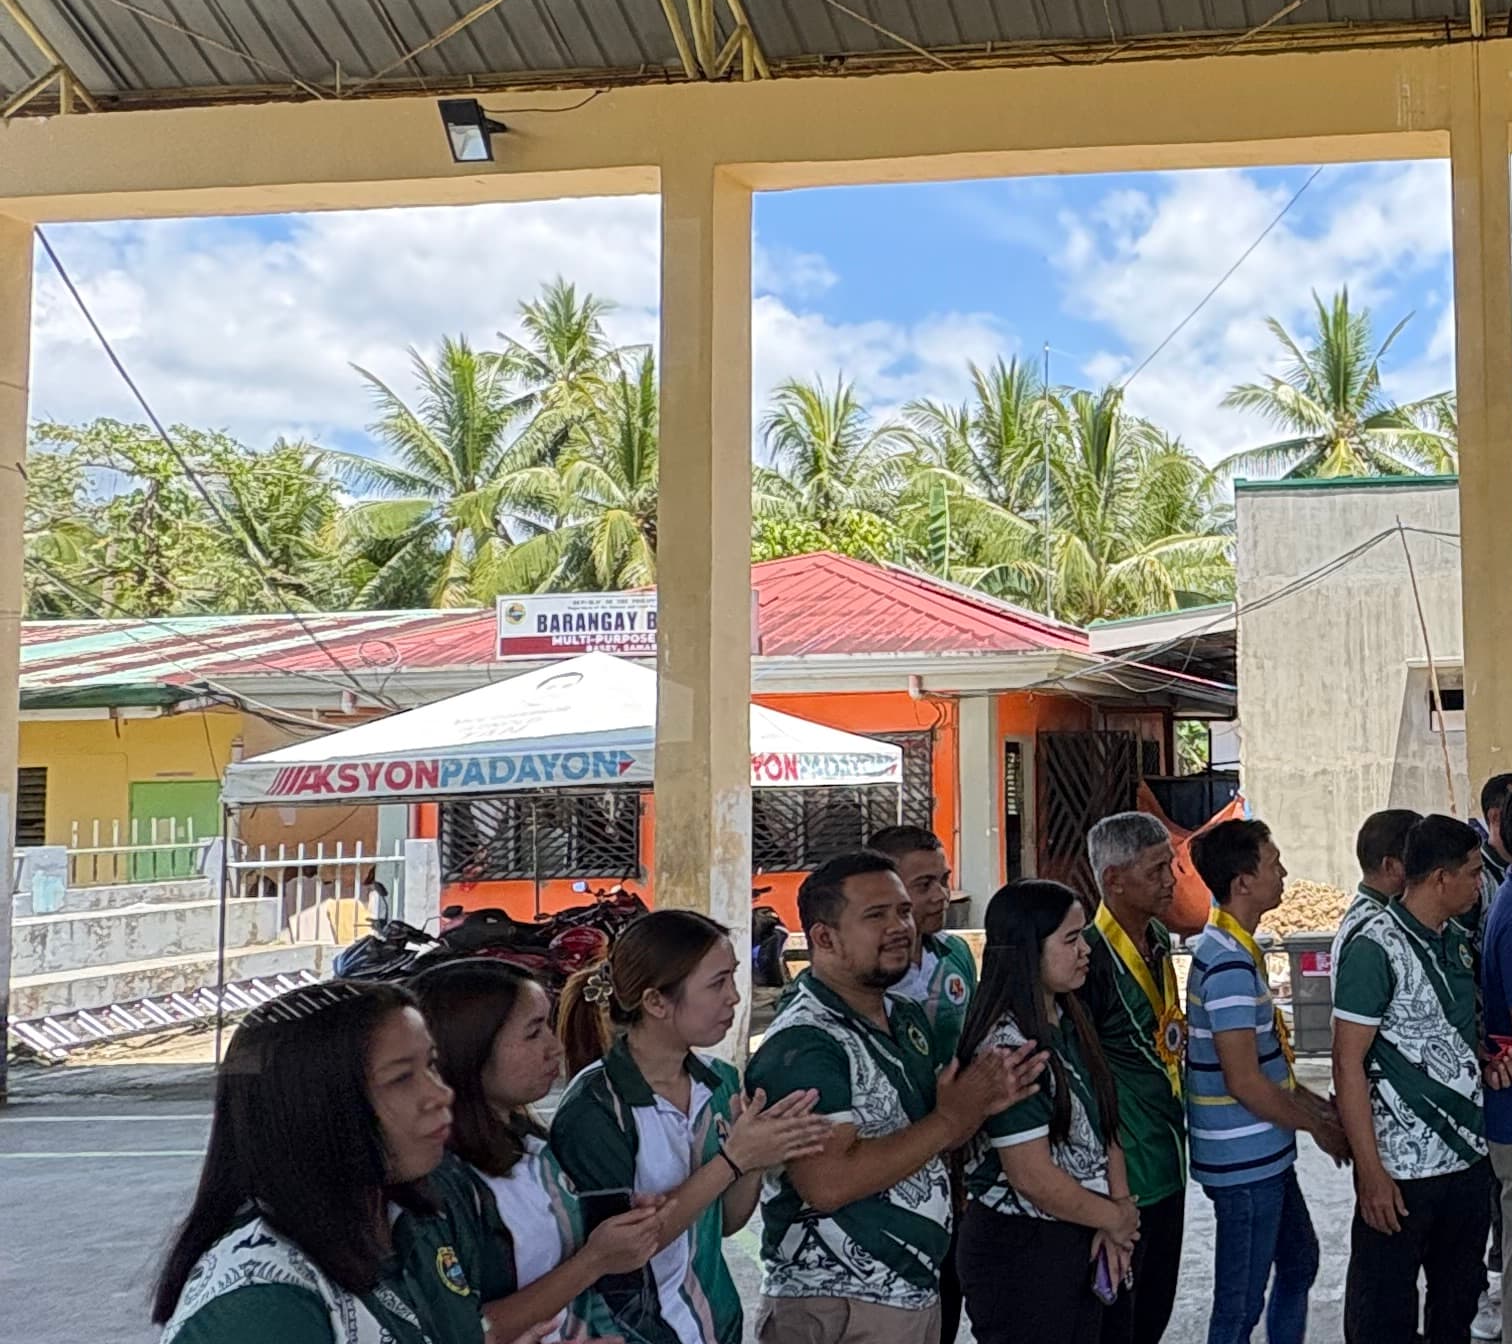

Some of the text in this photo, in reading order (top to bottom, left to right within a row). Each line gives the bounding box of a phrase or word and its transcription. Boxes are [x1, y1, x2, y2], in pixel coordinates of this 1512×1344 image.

[537, 610, 657, 633] BARANGAY B
[552, 633, 656, 645] MULTI-PURPOSE
